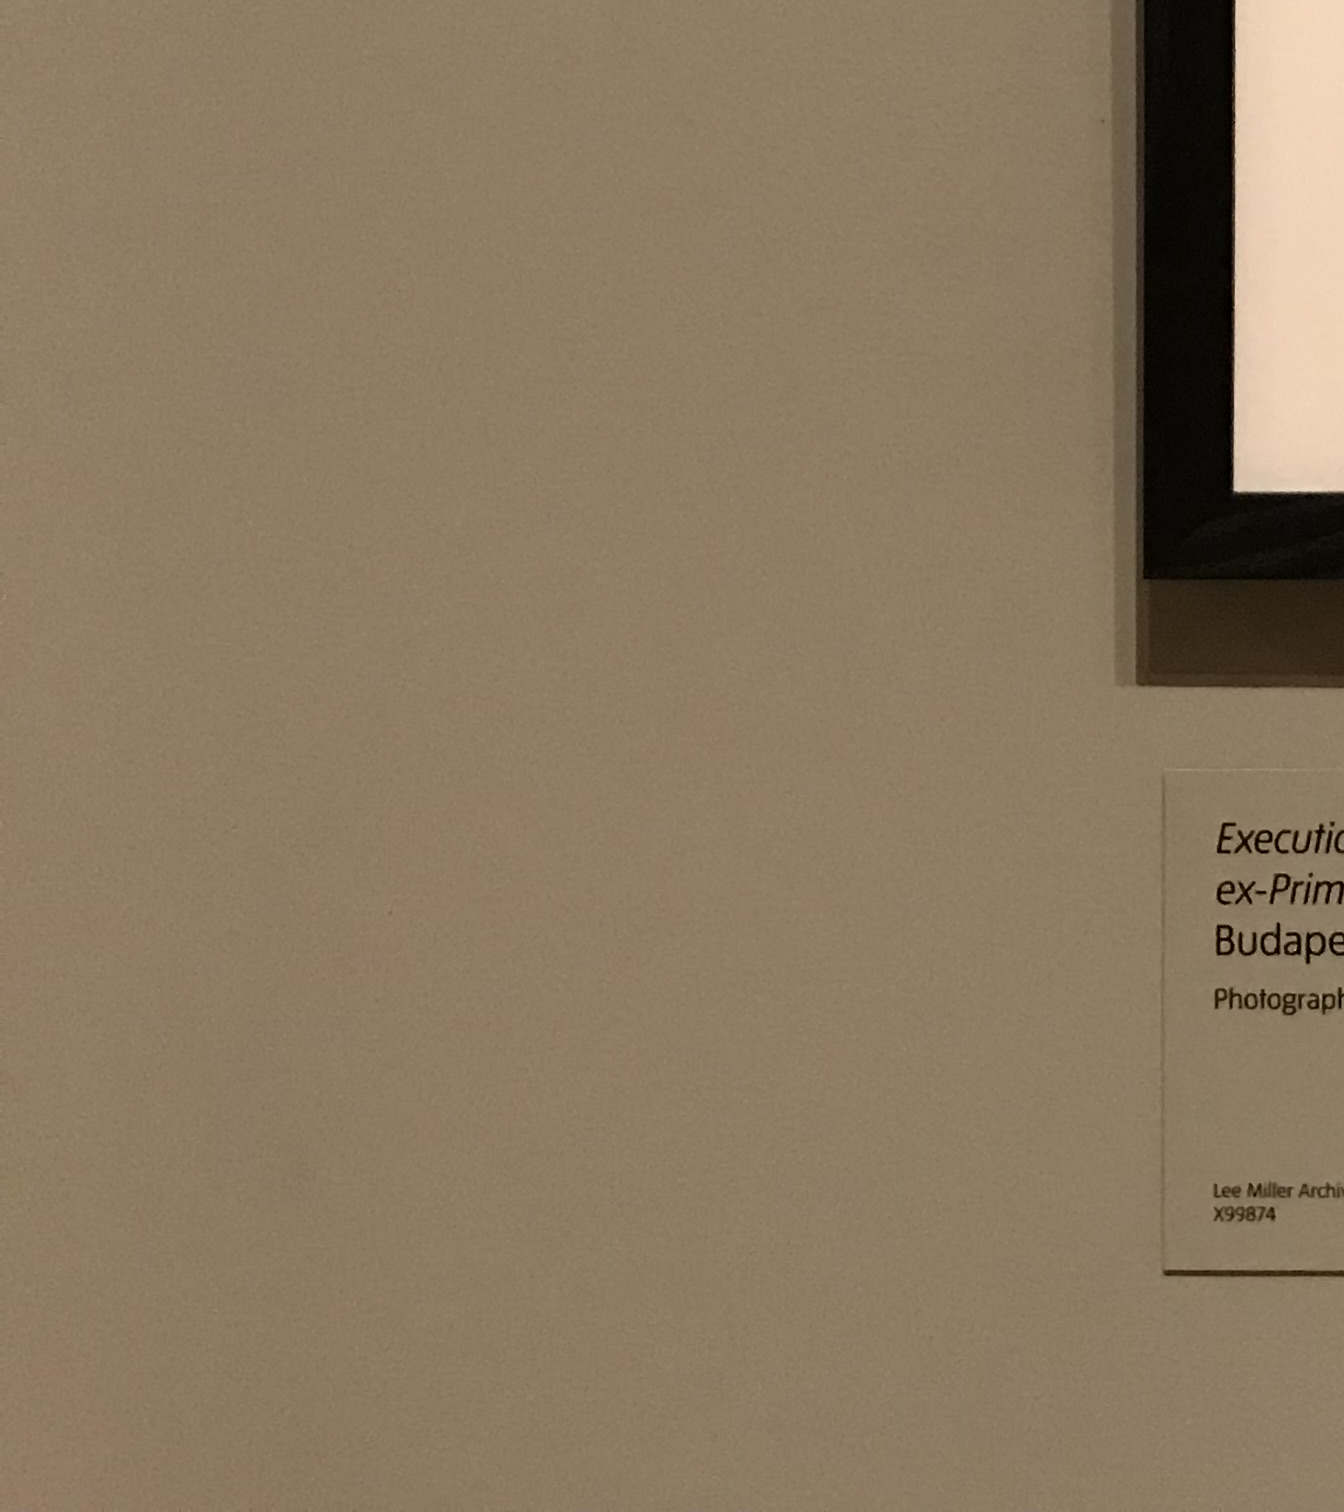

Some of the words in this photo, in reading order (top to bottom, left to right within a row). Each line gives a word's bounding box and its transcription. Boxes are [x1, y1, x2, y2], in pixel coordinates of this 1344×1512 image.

[1212, 1182, 1243, 1200] Lee
[1246, 1180, 1295, 1200] Miller
[1212, 1204, 1277, 1223] X99874
